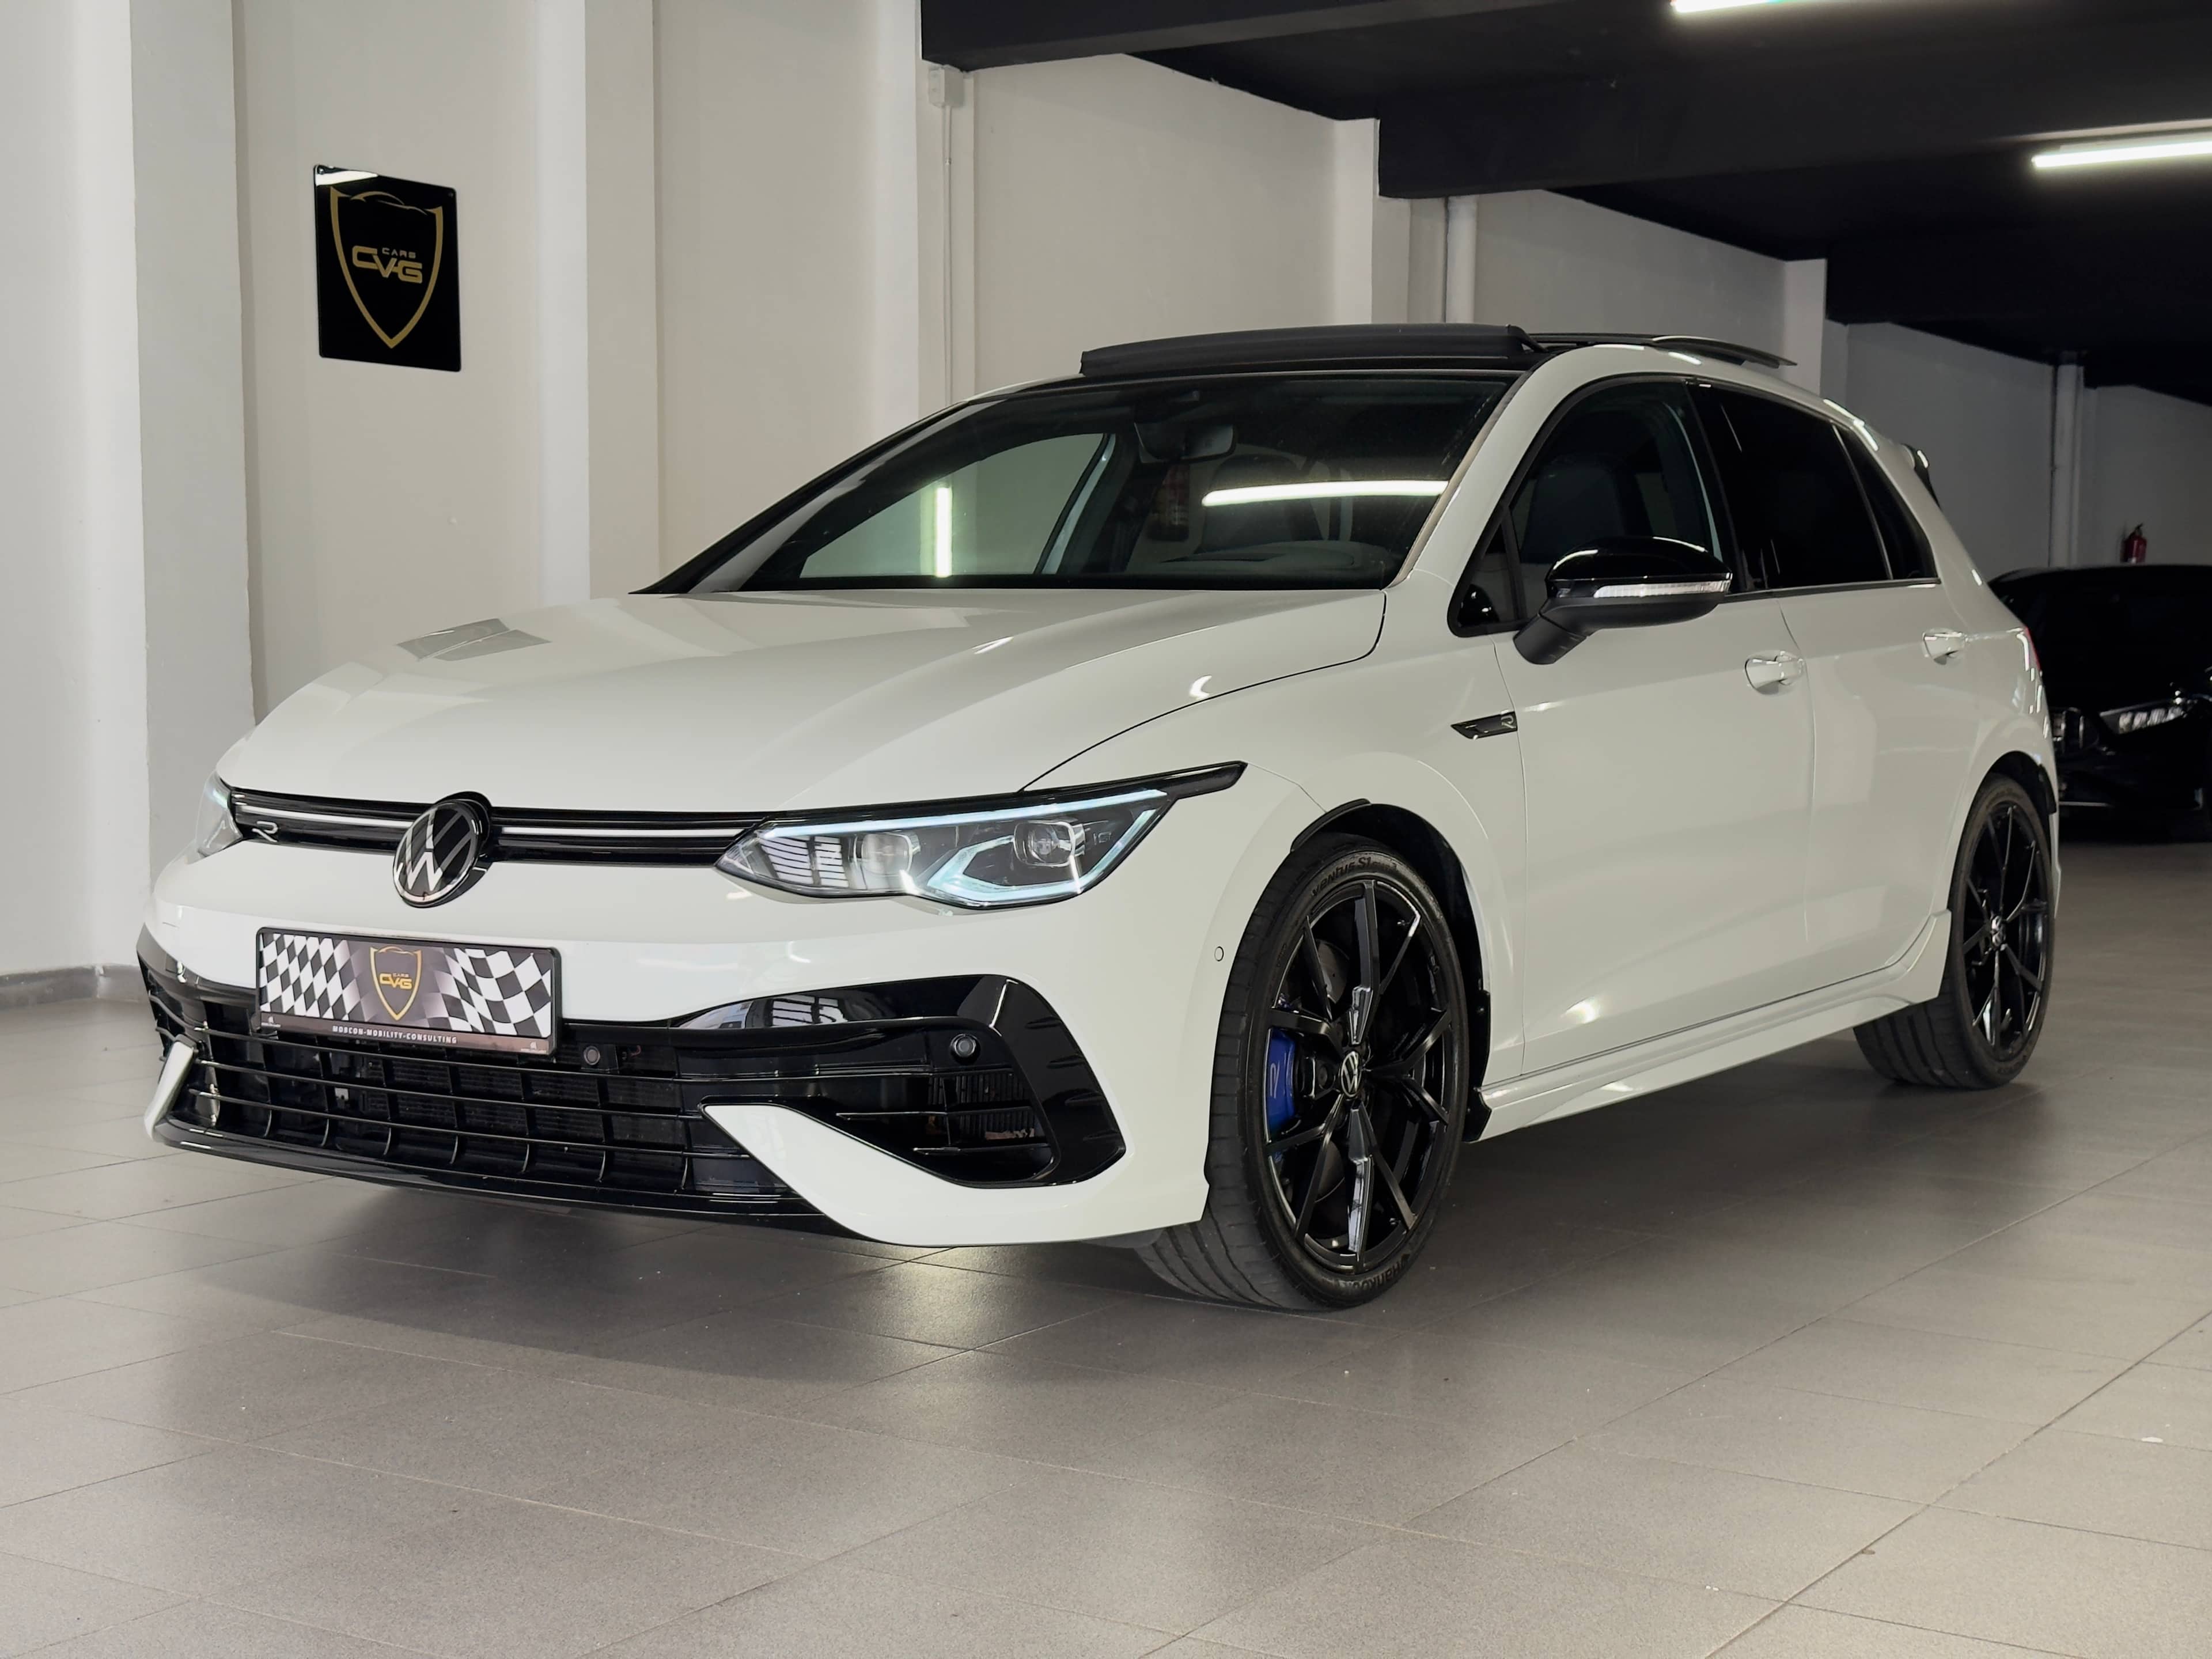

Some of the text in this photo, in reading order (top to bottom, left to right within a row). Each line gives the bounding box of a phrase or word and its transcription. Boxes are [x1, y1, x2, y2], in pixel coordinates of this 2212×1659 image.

[382, 247, 416, 259] CARS
[352, 245, 423, 284] CVG
[252, 821, 278, 842] R
[380, 973, 412, 989] CVG
